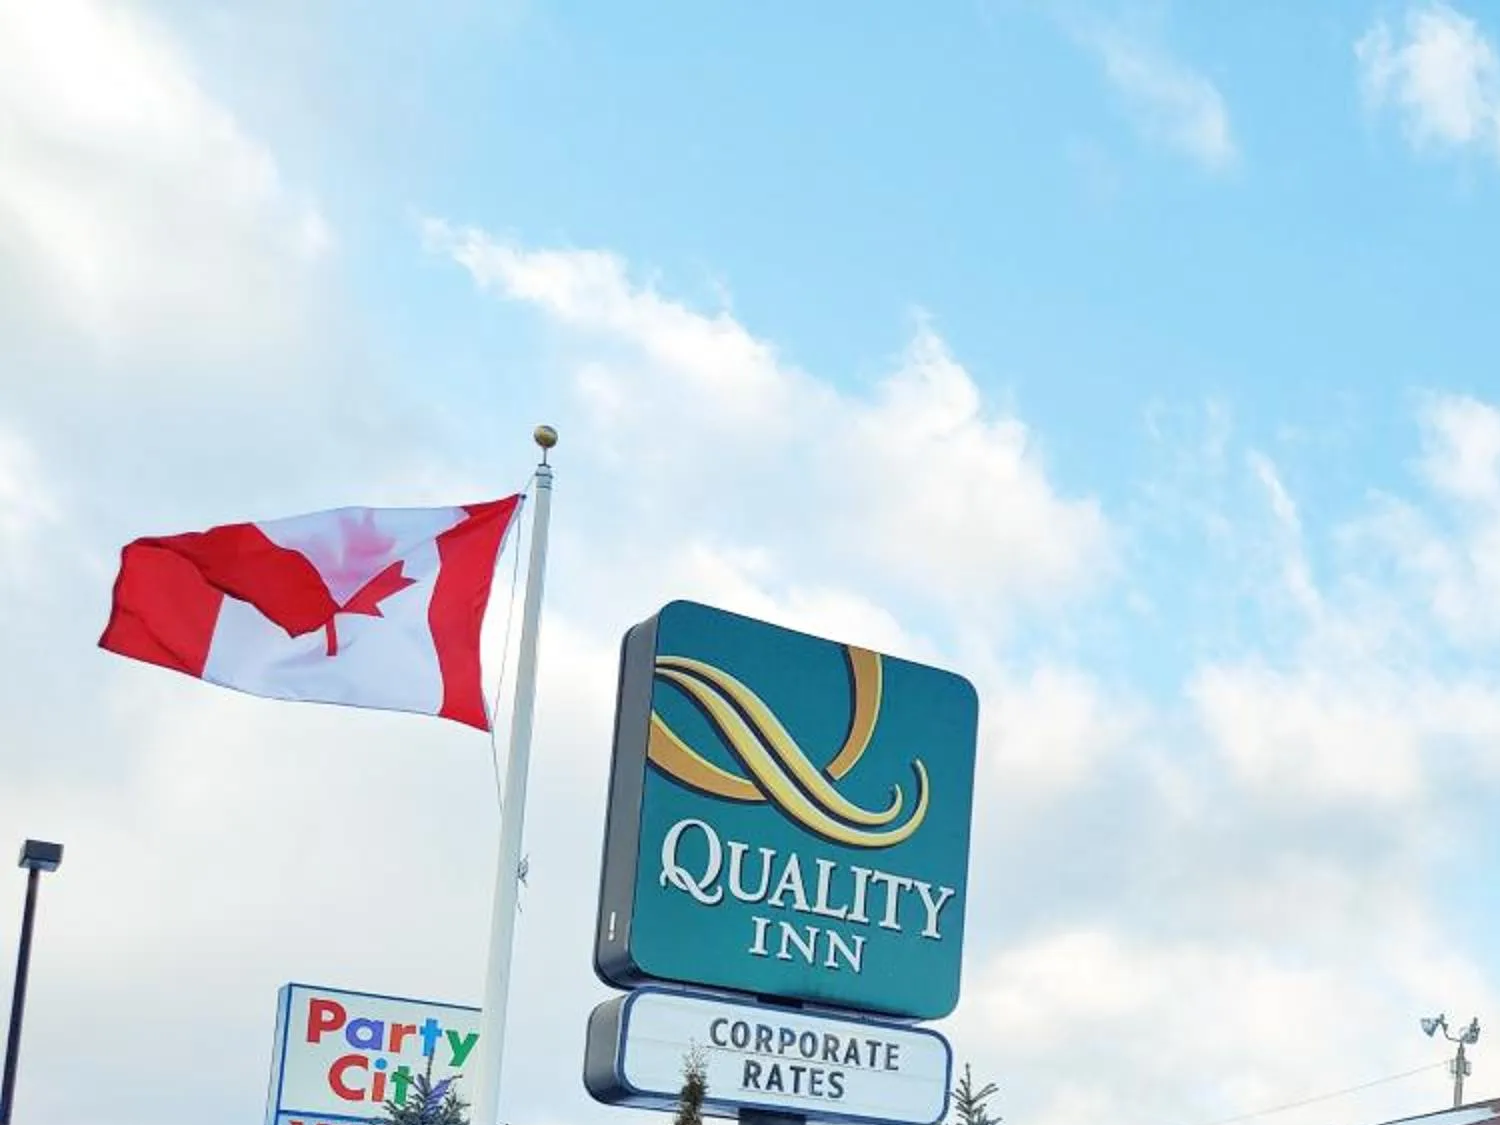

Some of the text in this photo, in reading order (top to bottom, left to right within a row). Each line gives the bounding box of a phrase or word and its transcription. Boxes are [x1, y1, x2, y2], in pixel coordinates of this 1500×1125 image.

[659, 818, 955, 940] QUALITY
[749, 915, 867, 974] INN
[306, 997, 480, 1067] Party
[709, 1016, 901, 1072] CORPORATE
[743, 1059, 845, 1099] RATES
